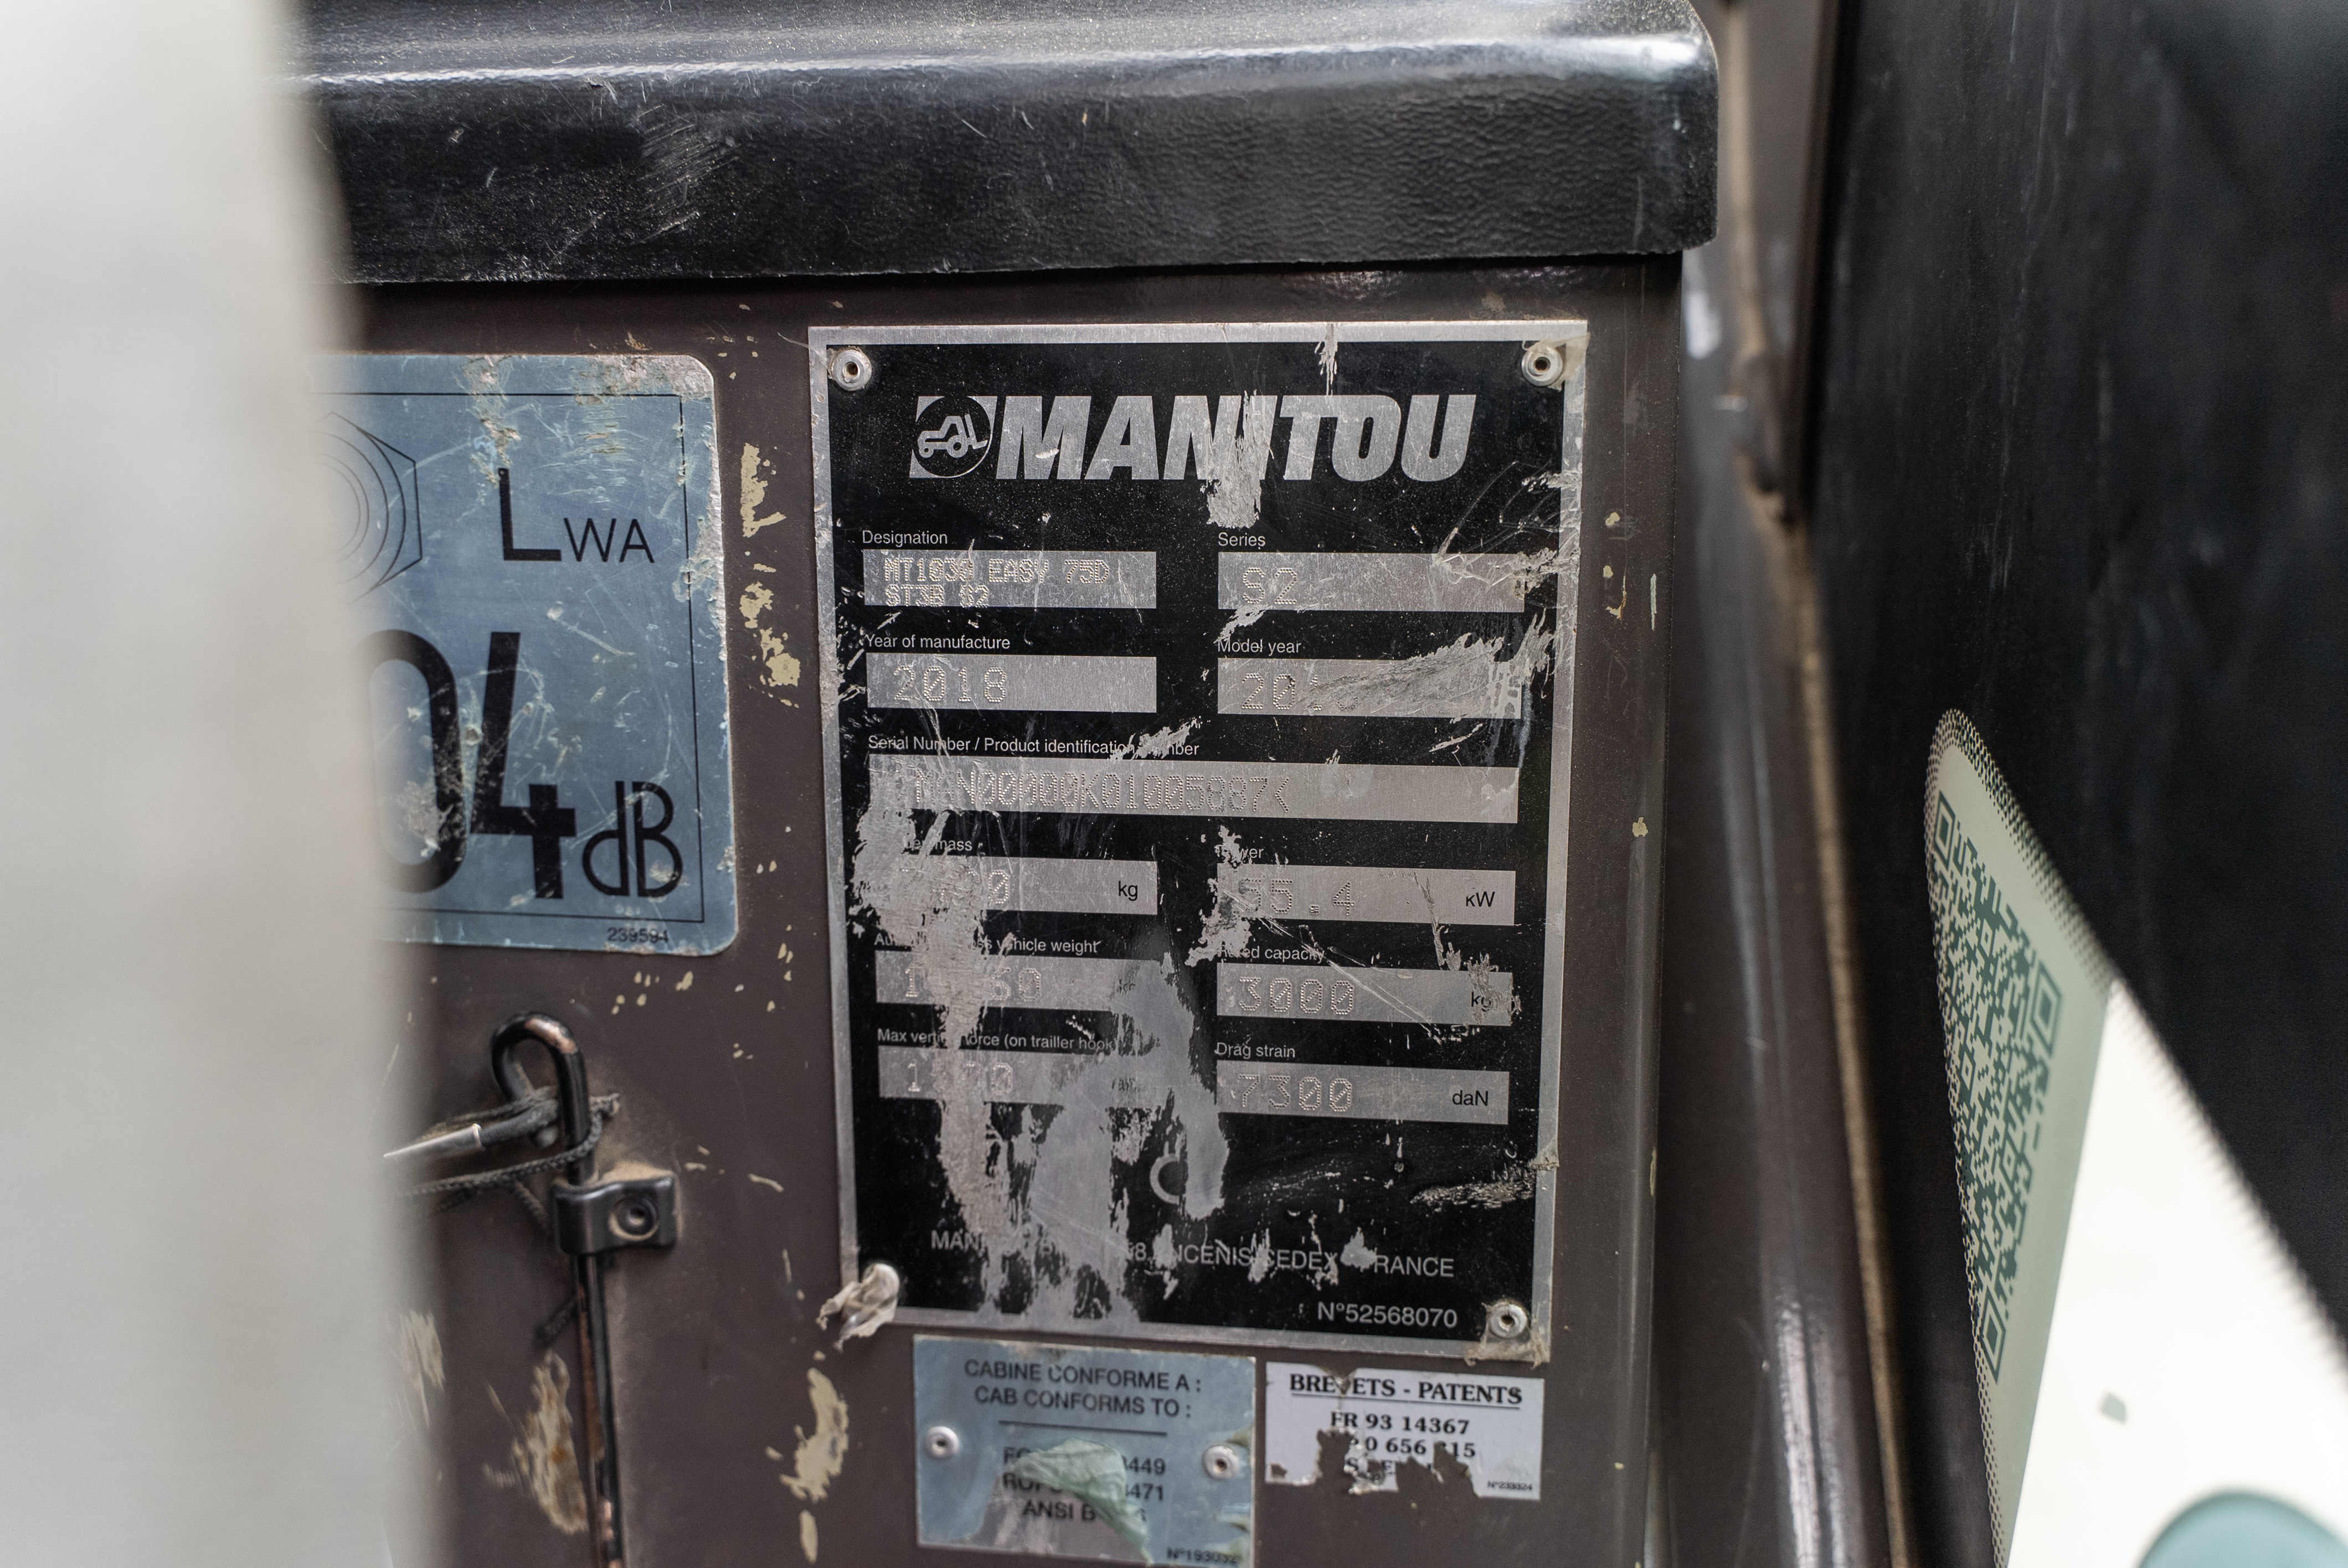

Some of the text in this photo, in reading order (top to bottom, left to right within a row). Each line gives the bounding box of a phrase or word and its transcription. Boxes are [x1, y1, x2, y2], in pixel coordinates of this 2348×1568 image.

[997, 394, 1477, 481] MANITOU
[862, 530, 948, 547] Designation
[1218, 532, 1266, 547] Series
[884, 558, 1109, 584] MT1030 EASY 75D
[884, 584, 990, 608] ST3B S2
[1242, 567, 1297, 605] S2
[866, 635, 1011, 649] Year of manufacture
[1218, 638, 1302, 656] Model year
[893, 665, 1007, 703] 2018
[868, 735, 909, 749] Serial
[913, 736, 971, 751] Number
[974, 737, 980, 751] /
[984, 737, 1040, 753] Product
[1044, 739, 1135, 756] identification
[582, 781, 683, 898] dB
[936, 839, 973, 852] mass
[1118, 880, 1139, 901] kg
[996, 938, 1046, 952] vhicle
[1051, 941, 1100, 956] weight
[1264, 947, 1325, 964] capacity
[1239, 976, 1353, 1015] 3000
[1471, 991, 1492, 1012] kg
[878, 1028, 907, 1043] Max
[1004, 1033, 1027, 1049] (on
[1031, 1034, 1074, 1049] trailler
[1217, 1042, 1295, 1059] Drag strain
[1238, 1073, 1352, 1113] 7300
[1451, 1089, 1489, 1106] daN
[1364, 1253, 1454, 1278] RANCE
[1317, 1301, 1458, 1329] N°52568070
[964, 1358, 1042, 1381] CABINE
[1048, 1364, 1170, 1391] CONFORME
[1175, 1373, 1190, 1391] A
[974, 1385, 1018, 1406] CAB
[1024, 1389, 1145, 1415] CONFORMS
[1151, 1397, 1180, 1417] TO
[1418, 1381, 1522, 1404] PATENTS
[1330, 1411, 1470, 1435] FR 93 14367
[1386, 1437, 1427, 1455] 656
[1435, 1441, 1476, 1458] 15
[1120, 1454, 1166, 1476] 449
[1125, 1483, 1164, 1502] 471
[1022, 1498, 1074, 1520] ANSI
